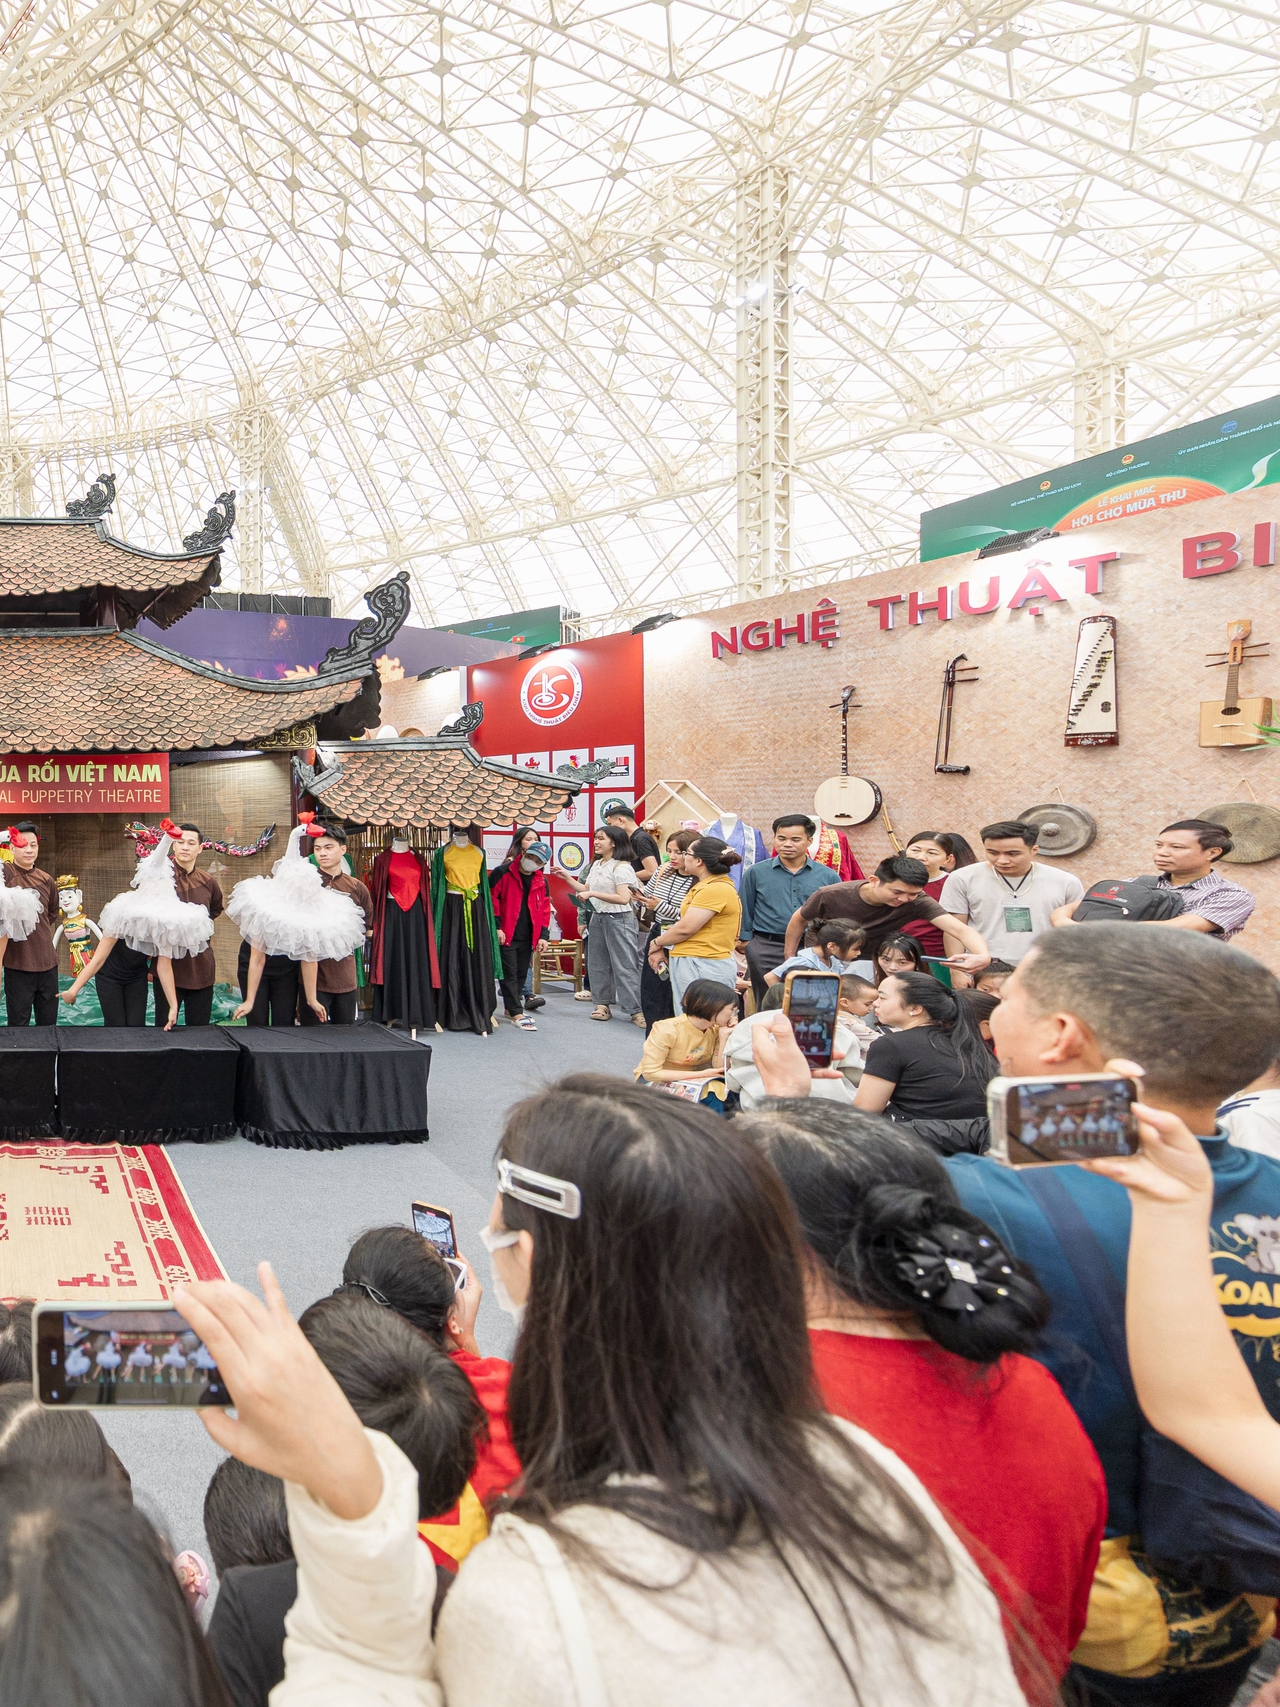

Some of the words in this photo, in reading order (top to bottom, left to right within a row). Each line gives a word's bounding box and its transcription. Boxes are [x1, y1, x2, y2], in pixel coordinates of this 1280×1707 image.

[1071, 514, 1094, 529] HỘI
[1159, 488, 1187, 504] THU
[1110, 491, 1132, 505] KHAI
[711, 597, 841, 660] NGHỆ
[867, 551, 1122, 631] THUẬT
[28, 758, 60, 783] RỐI
[66, 761, 107, 786] VIỆT
[113, 764, 162, 783] NAM
[21, 789, 93, 803] PUPPETRY
[98, 789, 162, 803] THEATRE
